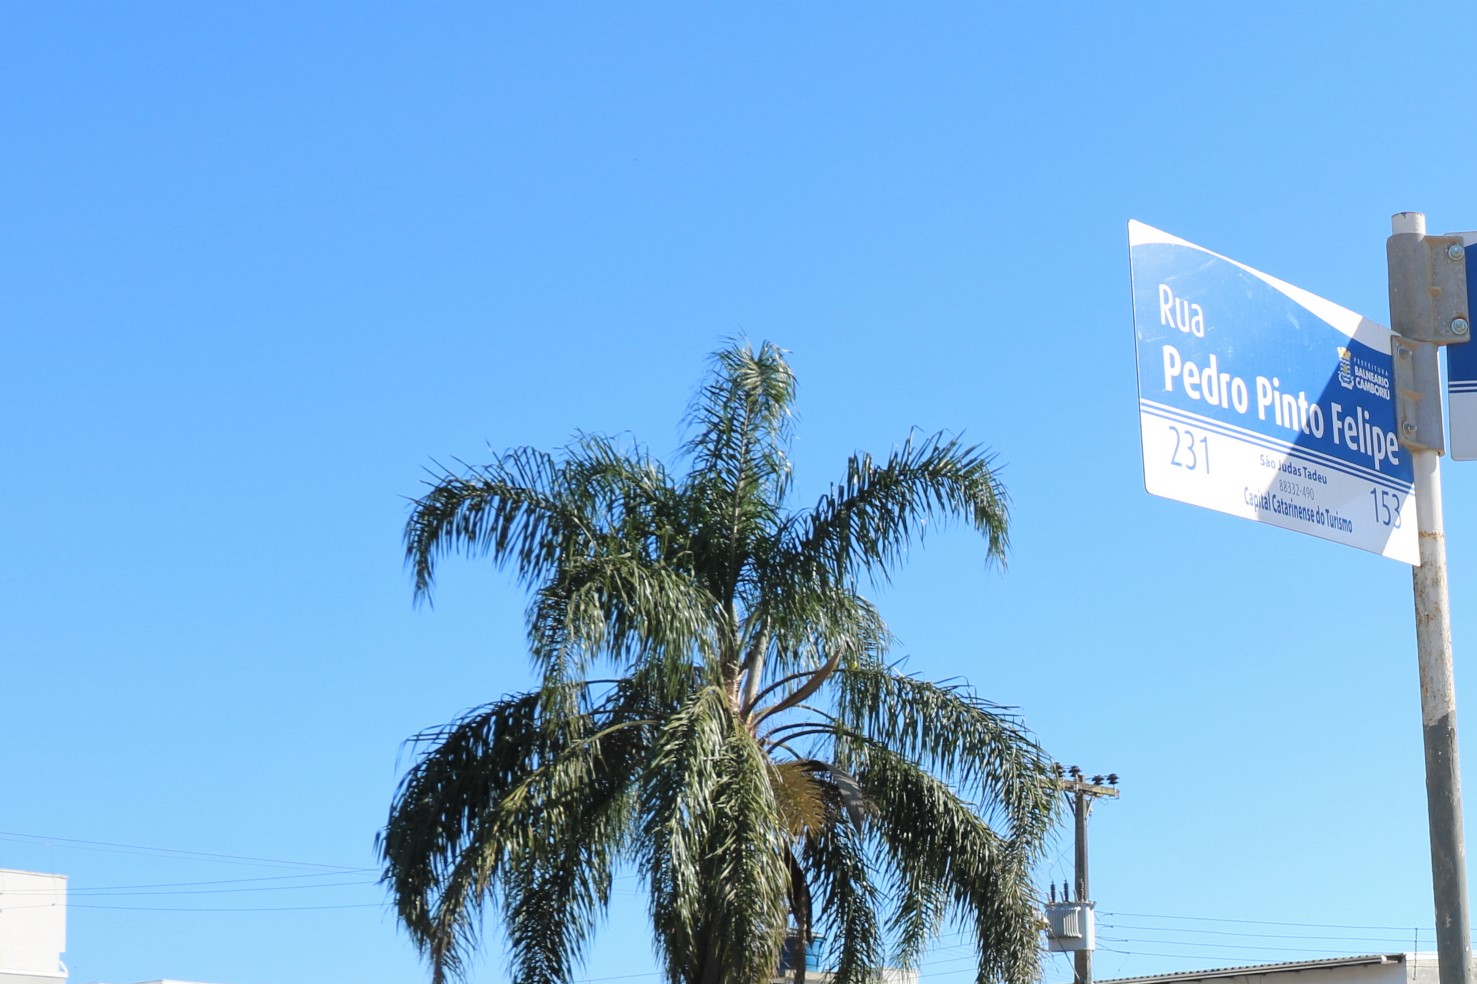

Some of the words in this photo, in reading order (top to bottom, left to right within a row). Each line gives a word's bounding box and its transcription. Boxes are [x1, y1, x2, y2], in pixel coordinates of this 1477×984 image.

[1159, 284, 1205, 338] Rua
[1162, 345, 1248, 415] Pedro
[1256, 375, 1325, 440] Pinto
[1332, 402, 1400, 471] Felipe
[1169, 425, 1210, 475] 231
[1260, 454, 1276, 470] São
[1278, 461, 1302, 477] Judas
[1303, 466, 1328, 485] Tadeu
[1244, 487, 1271, 513] Capital
[1272, 494, 1315, 523] Catarinense
[1316, 509, 1325, 525] do
[1325, 508, 1353, 534] Turismo
[1278, 480, 1315, 501] 88332-490
[1370, 487, 1402, 529] 153
